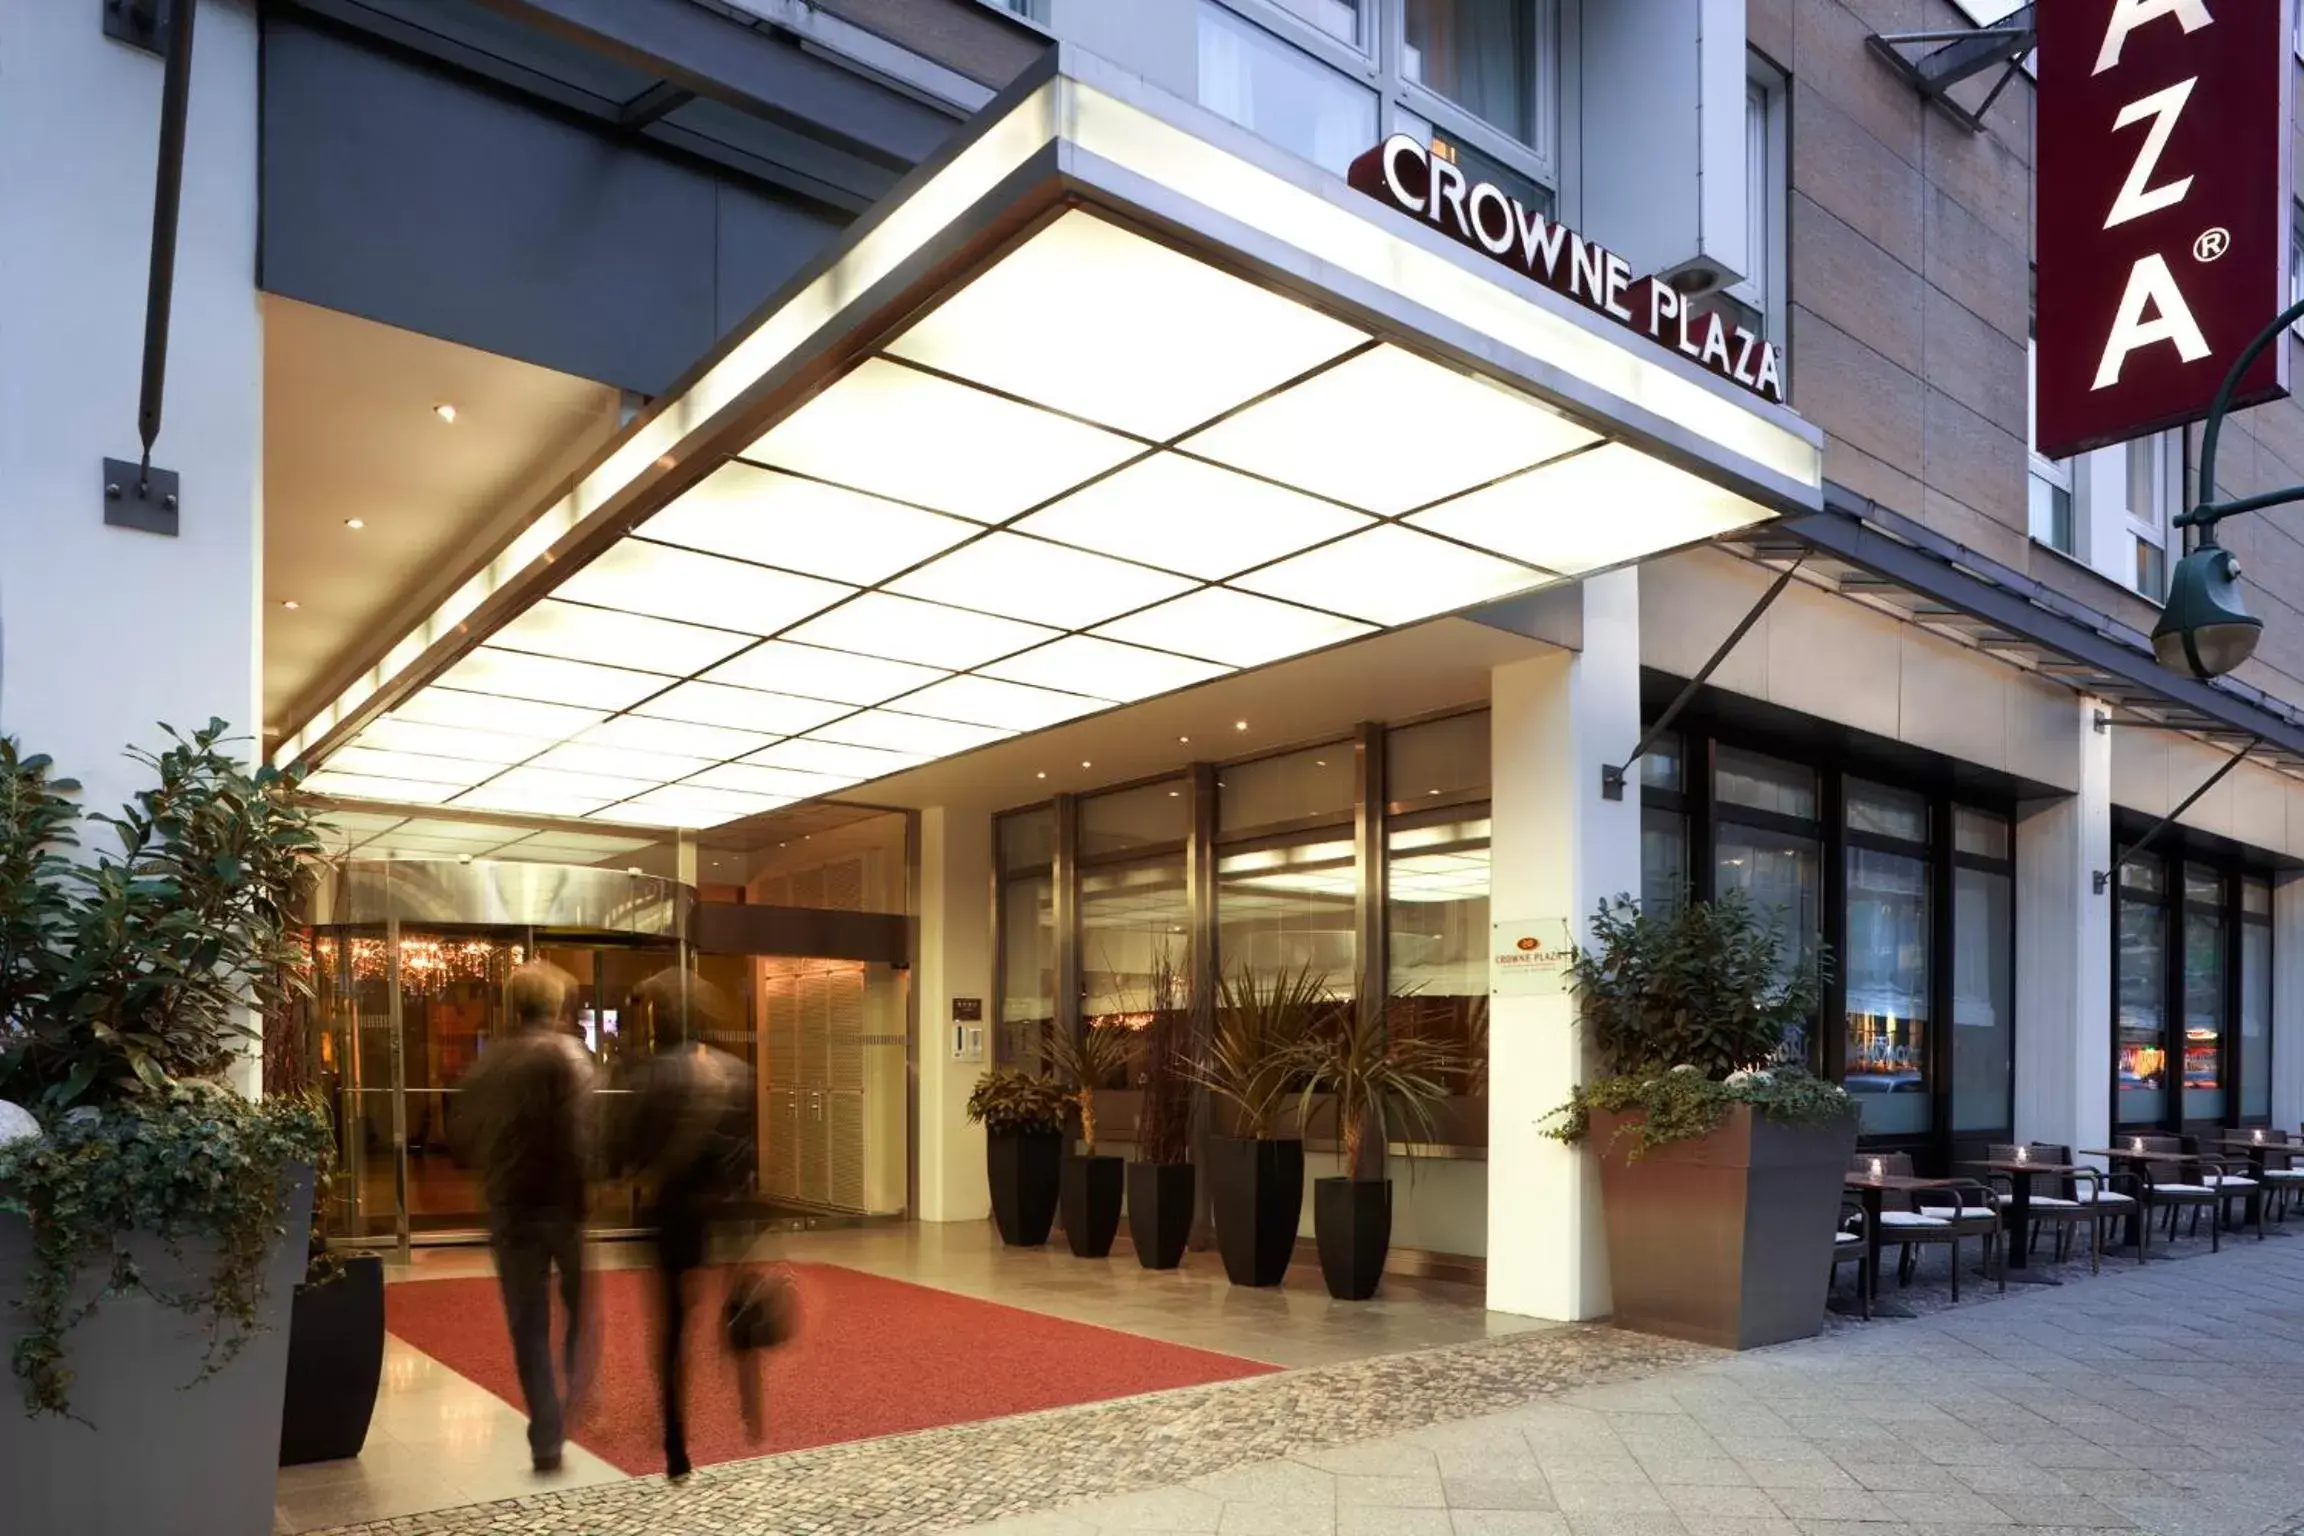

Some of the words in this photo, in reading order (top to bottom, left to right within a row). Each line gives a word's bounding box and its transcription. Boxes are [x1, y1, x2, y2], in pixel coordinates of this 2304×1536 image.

[1382, 132, 1634, 322] CROWNE
[1649, 274, 1783, 401] PLAZA
[1495, 953, 1531, 964] CROWNE
